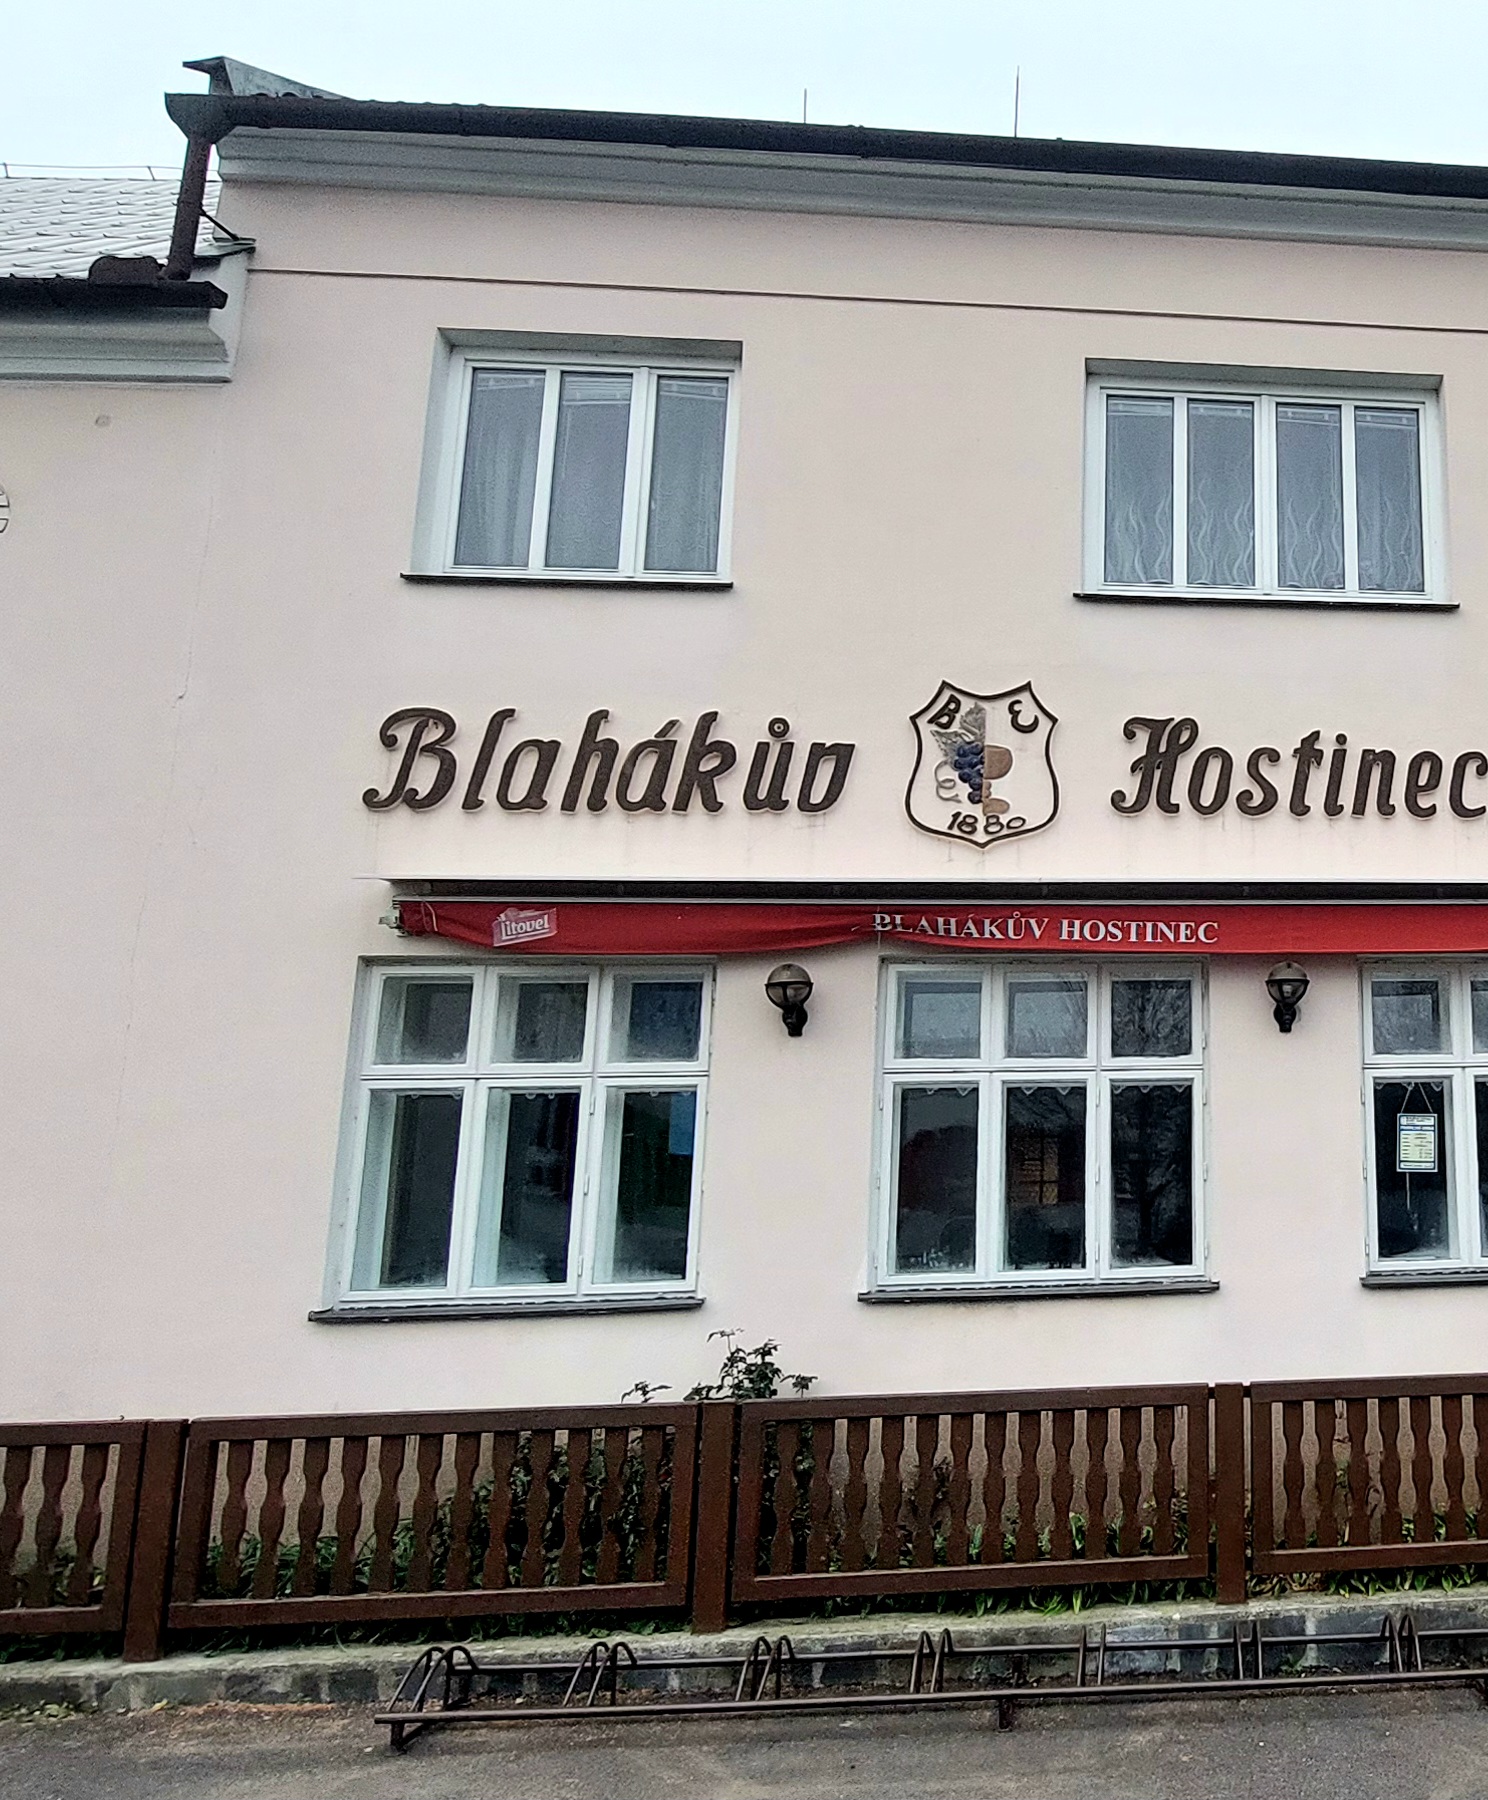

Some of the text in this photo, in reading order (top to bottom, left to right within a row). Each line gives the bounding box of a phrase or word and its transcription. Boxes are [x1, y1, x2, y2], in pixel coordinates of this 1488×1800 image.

[927, 694, 961, 729] B
[362, 707, 856, 812] Blahákův
[947, 811, 1026, 835] 1880
[501, 914, 550, 939] Litovel
[873, 911, 1219, 943] BLAHÁKŮV HOSTINEC
